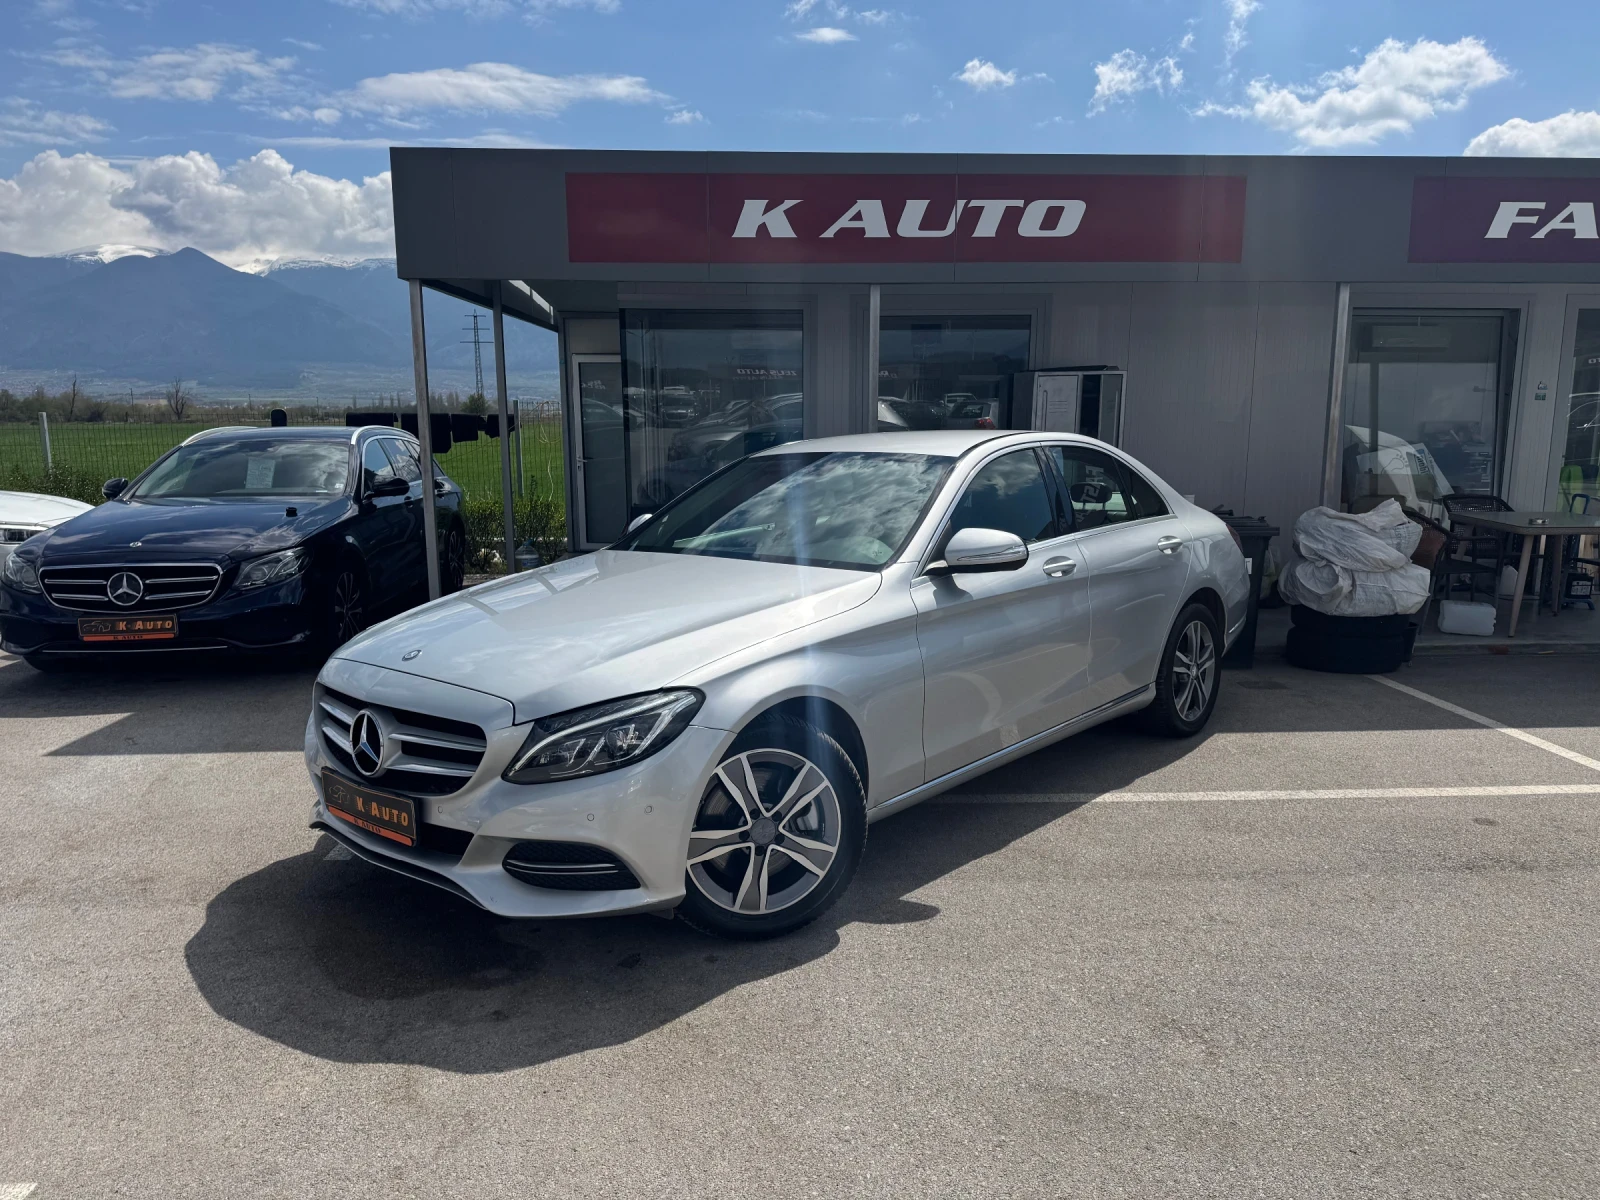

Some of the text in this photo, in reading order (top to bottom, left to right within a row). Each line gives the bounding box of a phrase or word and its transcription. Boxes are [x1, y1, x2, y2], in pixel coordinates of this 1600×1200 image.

[731, 199, 1087, 238] K AUTO
[1483, 201, 1600, 239] FA
[118, 620, 173, 631] K AUTO
[356, 796, 409, 827] K AUTO
